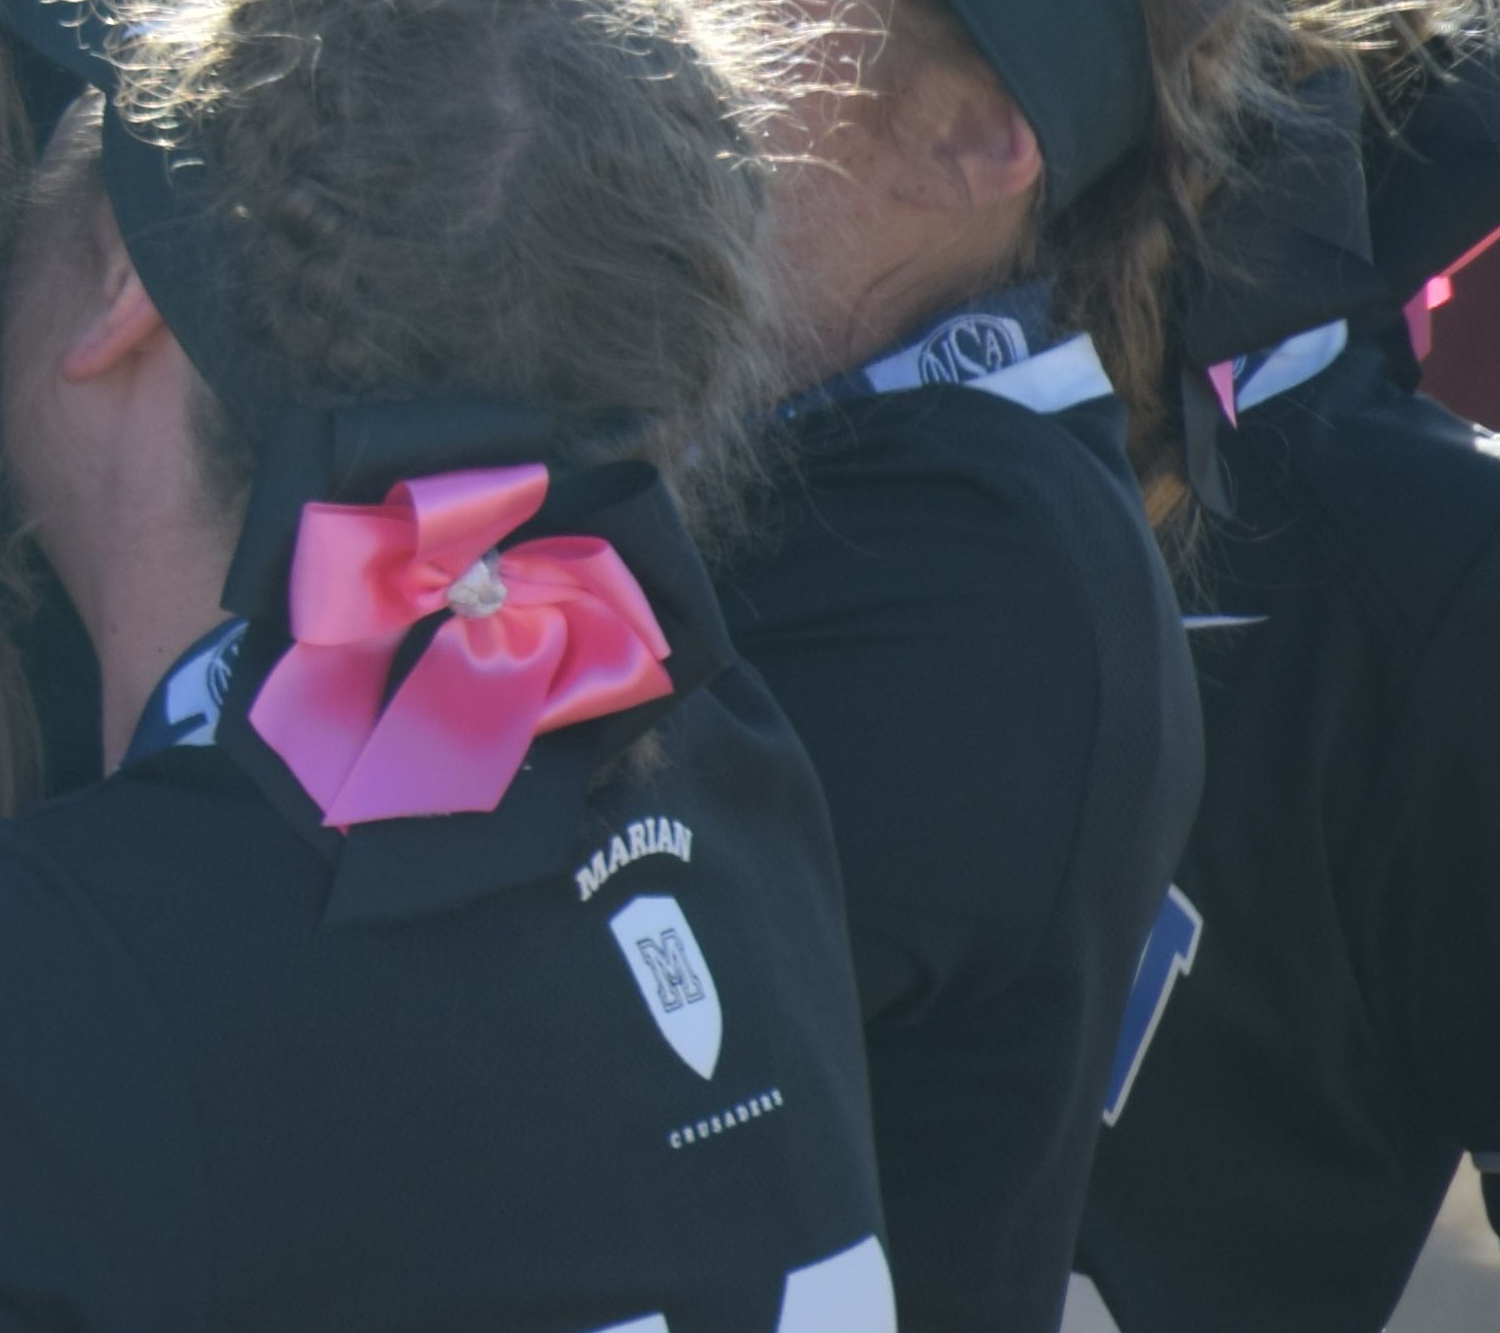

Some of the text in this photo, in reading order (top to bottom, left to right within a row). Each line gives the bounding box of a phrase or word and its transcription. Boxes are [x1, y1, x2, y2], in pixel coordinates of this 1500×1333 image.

[575, 817, 692, 902] MARIAN
[636, 928, 706, 1014] M
[668, 1089, 784, 1149] CRUSADERS
